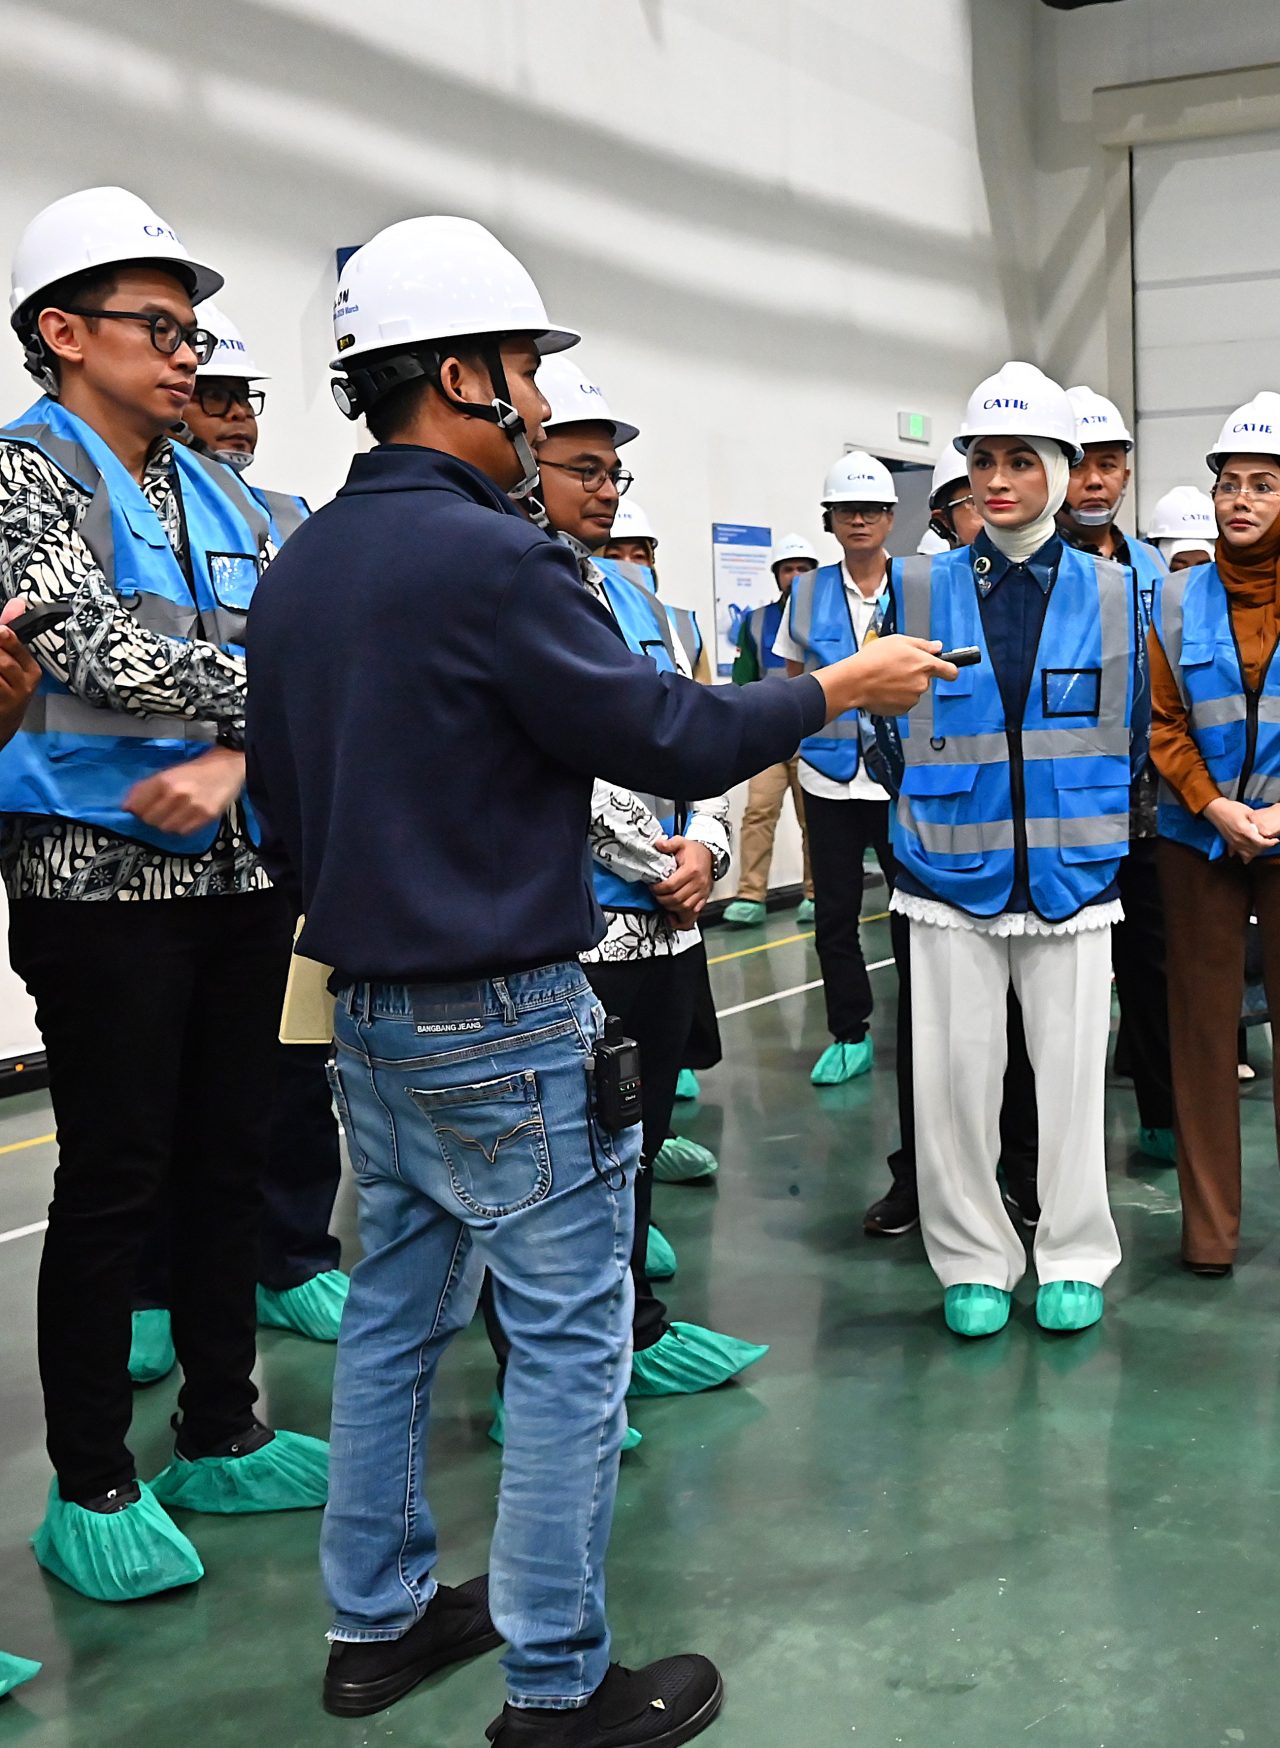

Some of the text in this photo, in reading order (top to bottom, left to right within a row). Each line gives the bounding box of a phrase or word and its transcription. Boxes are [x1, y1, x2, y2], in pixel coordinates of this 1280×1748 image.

[983, 398, 1029, 411] CATIB
[417, 1021, 481, 1033] BANGBANG JEANS
